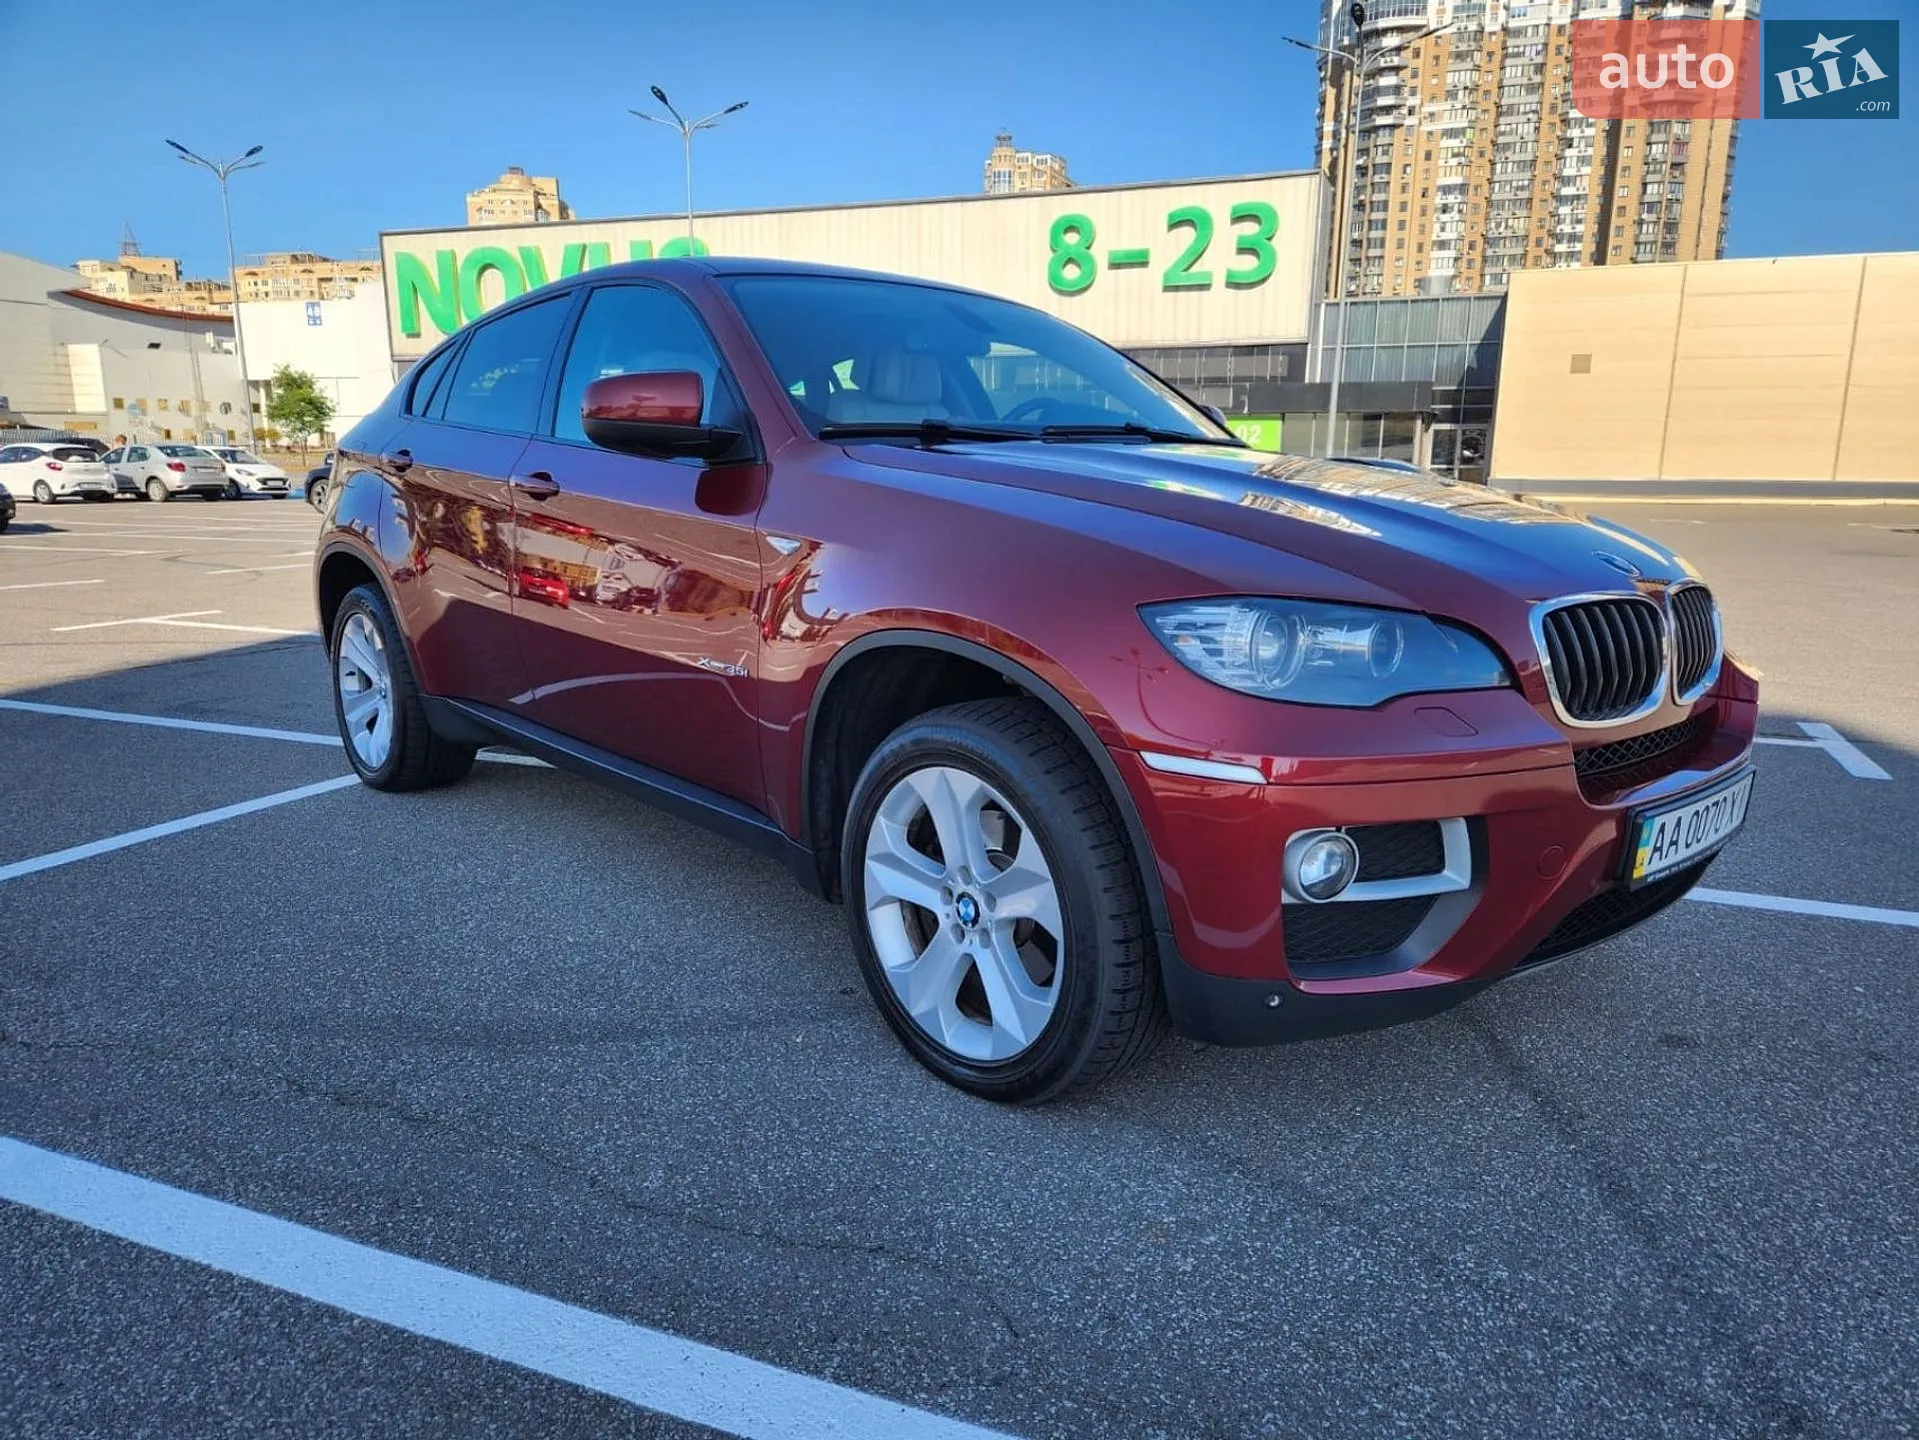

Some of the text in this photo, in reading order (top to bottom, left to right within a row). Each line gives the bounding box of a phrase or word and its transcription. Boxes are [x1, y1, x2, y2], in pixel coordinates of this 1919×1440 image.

[1047, 201, 1280, 293] 8-23
[1648, 815, 1683, 865] AA
[1685, 796, 1728, 849] 0070
